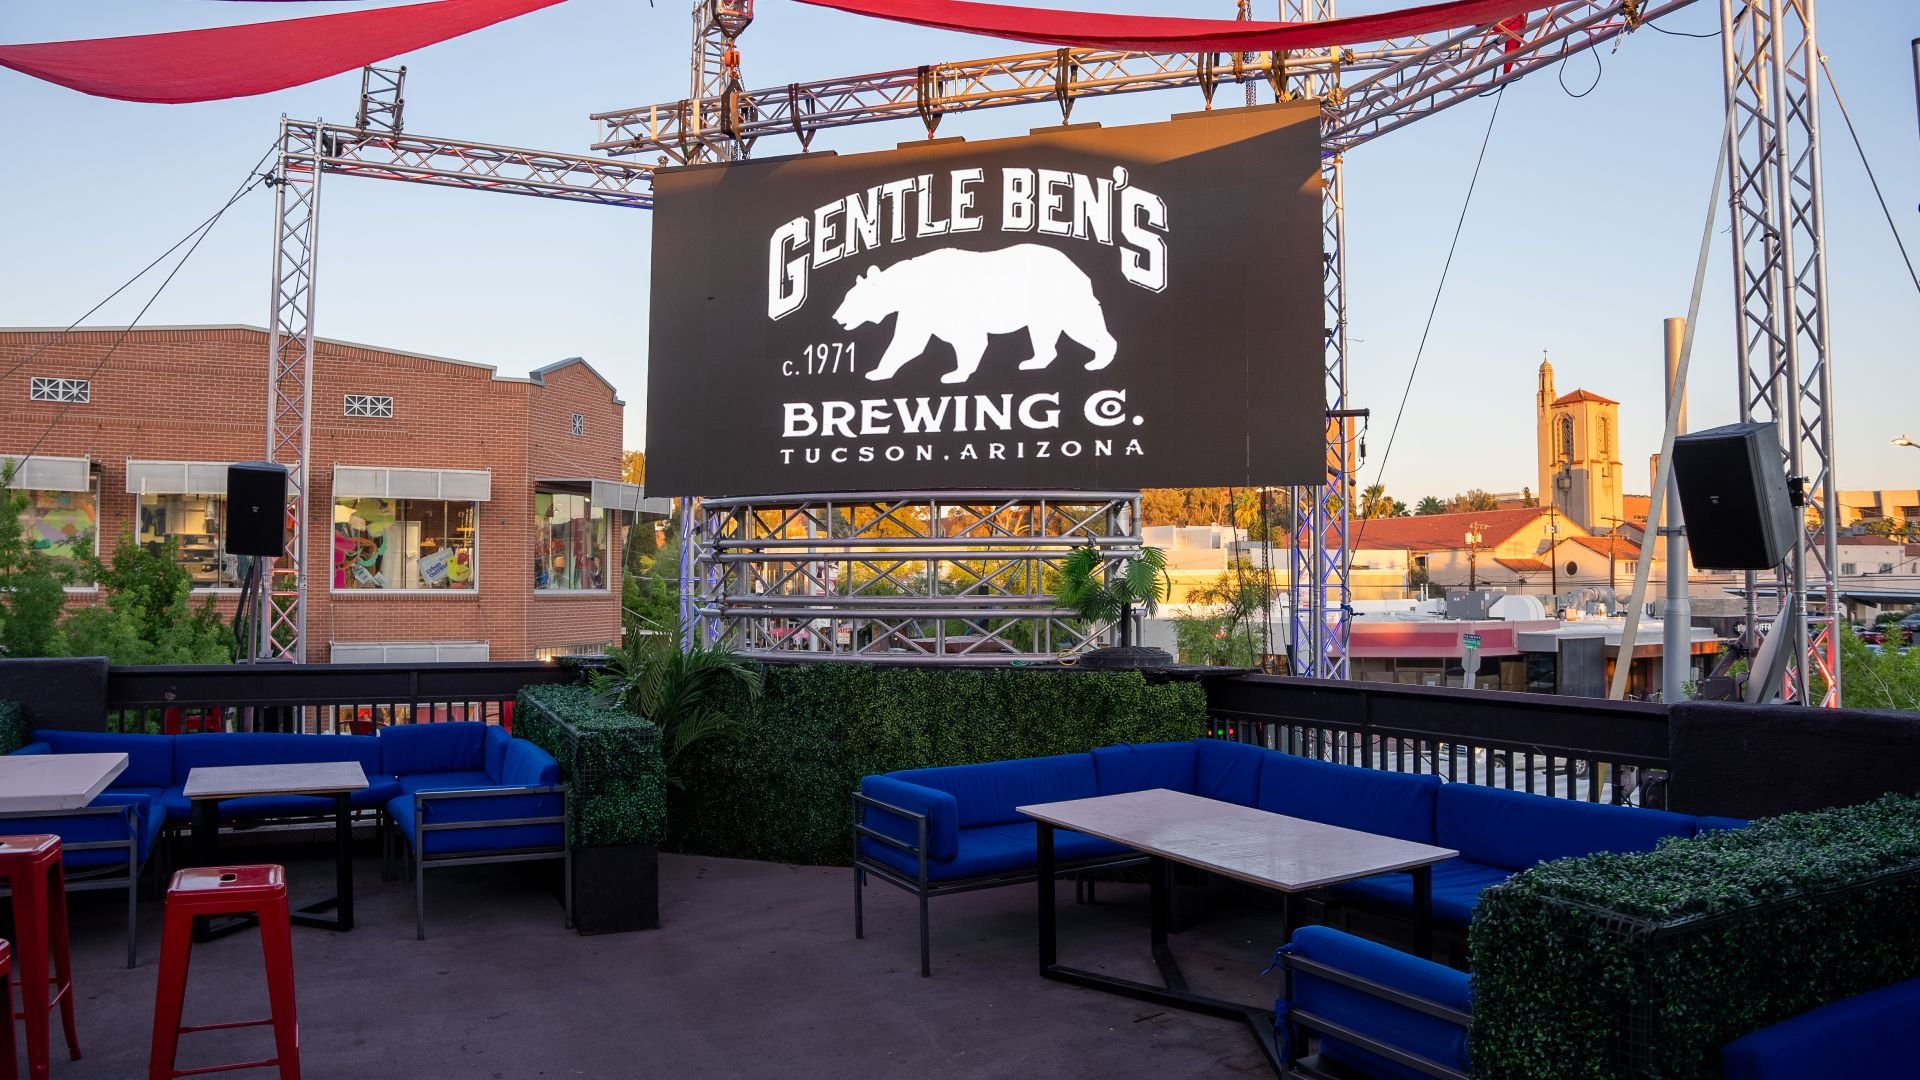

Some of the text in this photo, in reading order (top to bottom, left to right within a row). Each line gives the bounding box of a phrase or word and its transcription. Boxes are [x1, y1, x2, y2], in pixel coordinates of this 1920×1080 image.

[768, 165, 1169, 321] GENTLE BEN'S
[782, 391, 1061, 439] BREWING
